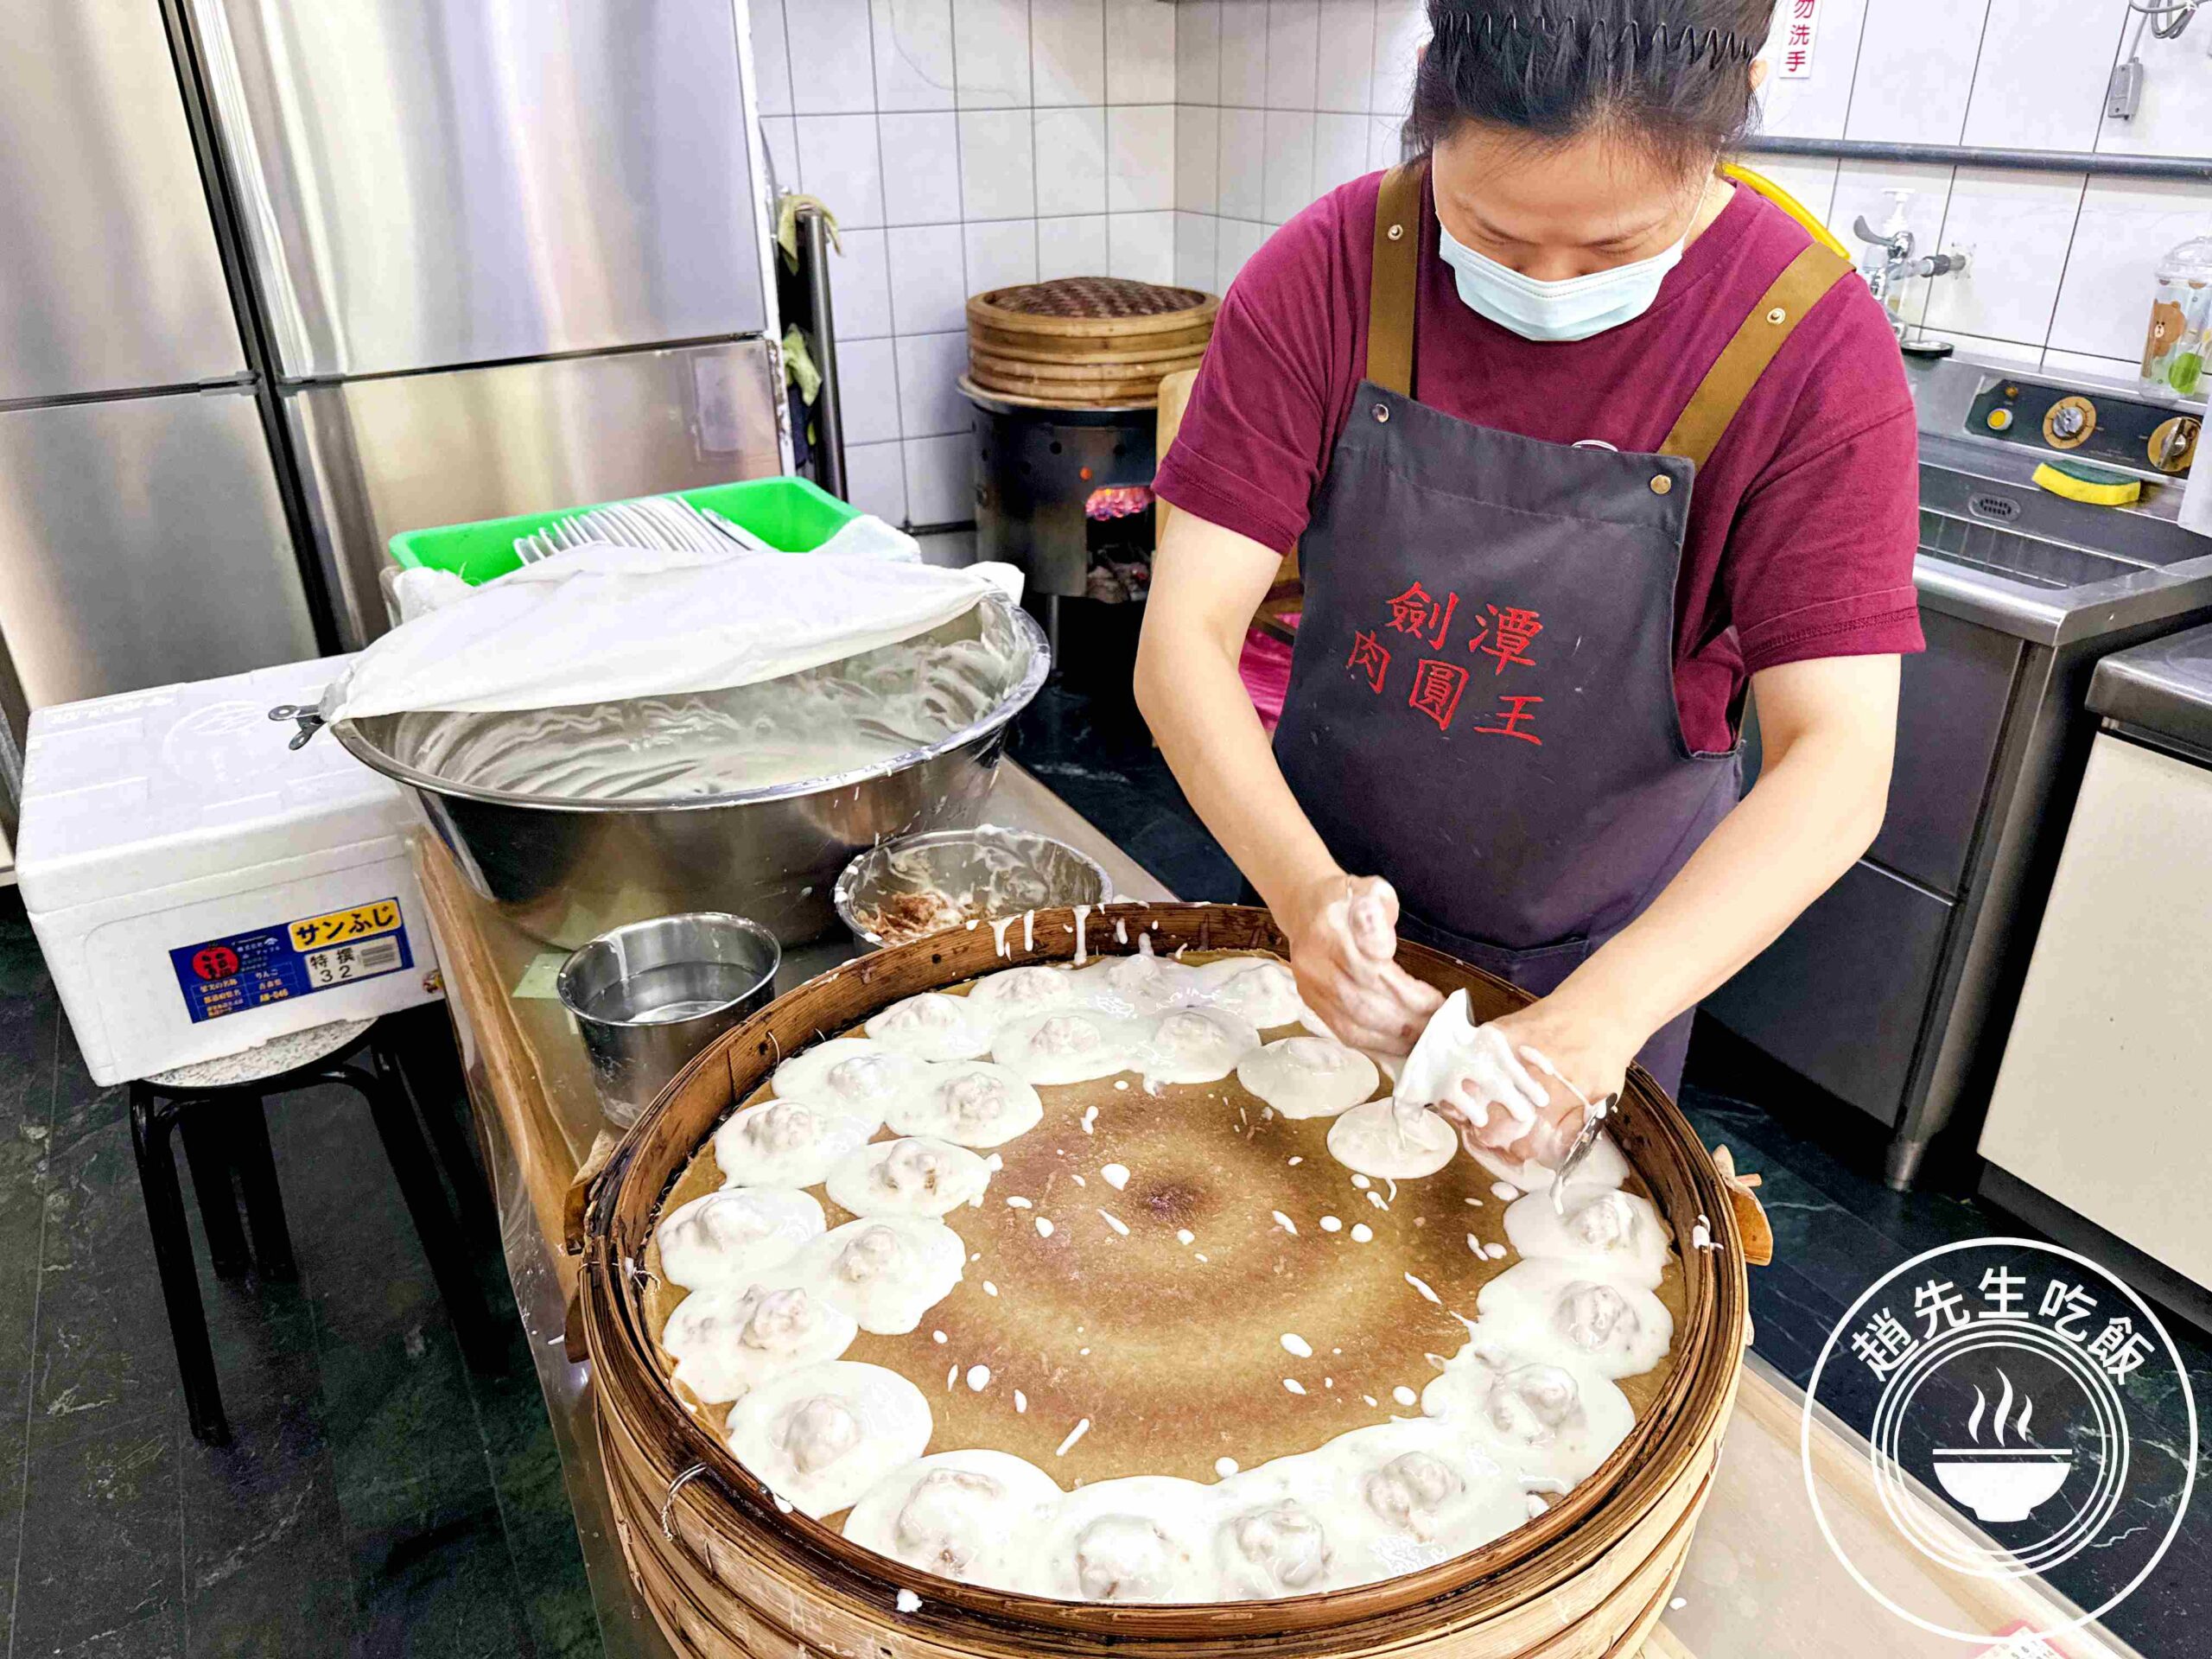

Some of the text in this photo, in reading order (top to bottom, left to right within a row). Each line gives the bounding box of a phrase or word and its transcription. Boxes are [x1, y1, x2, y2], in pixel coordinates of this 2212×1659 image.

[1785, 0, 1815, 72] 勿洗手
[296, 906, 394, 945] サンふじ
